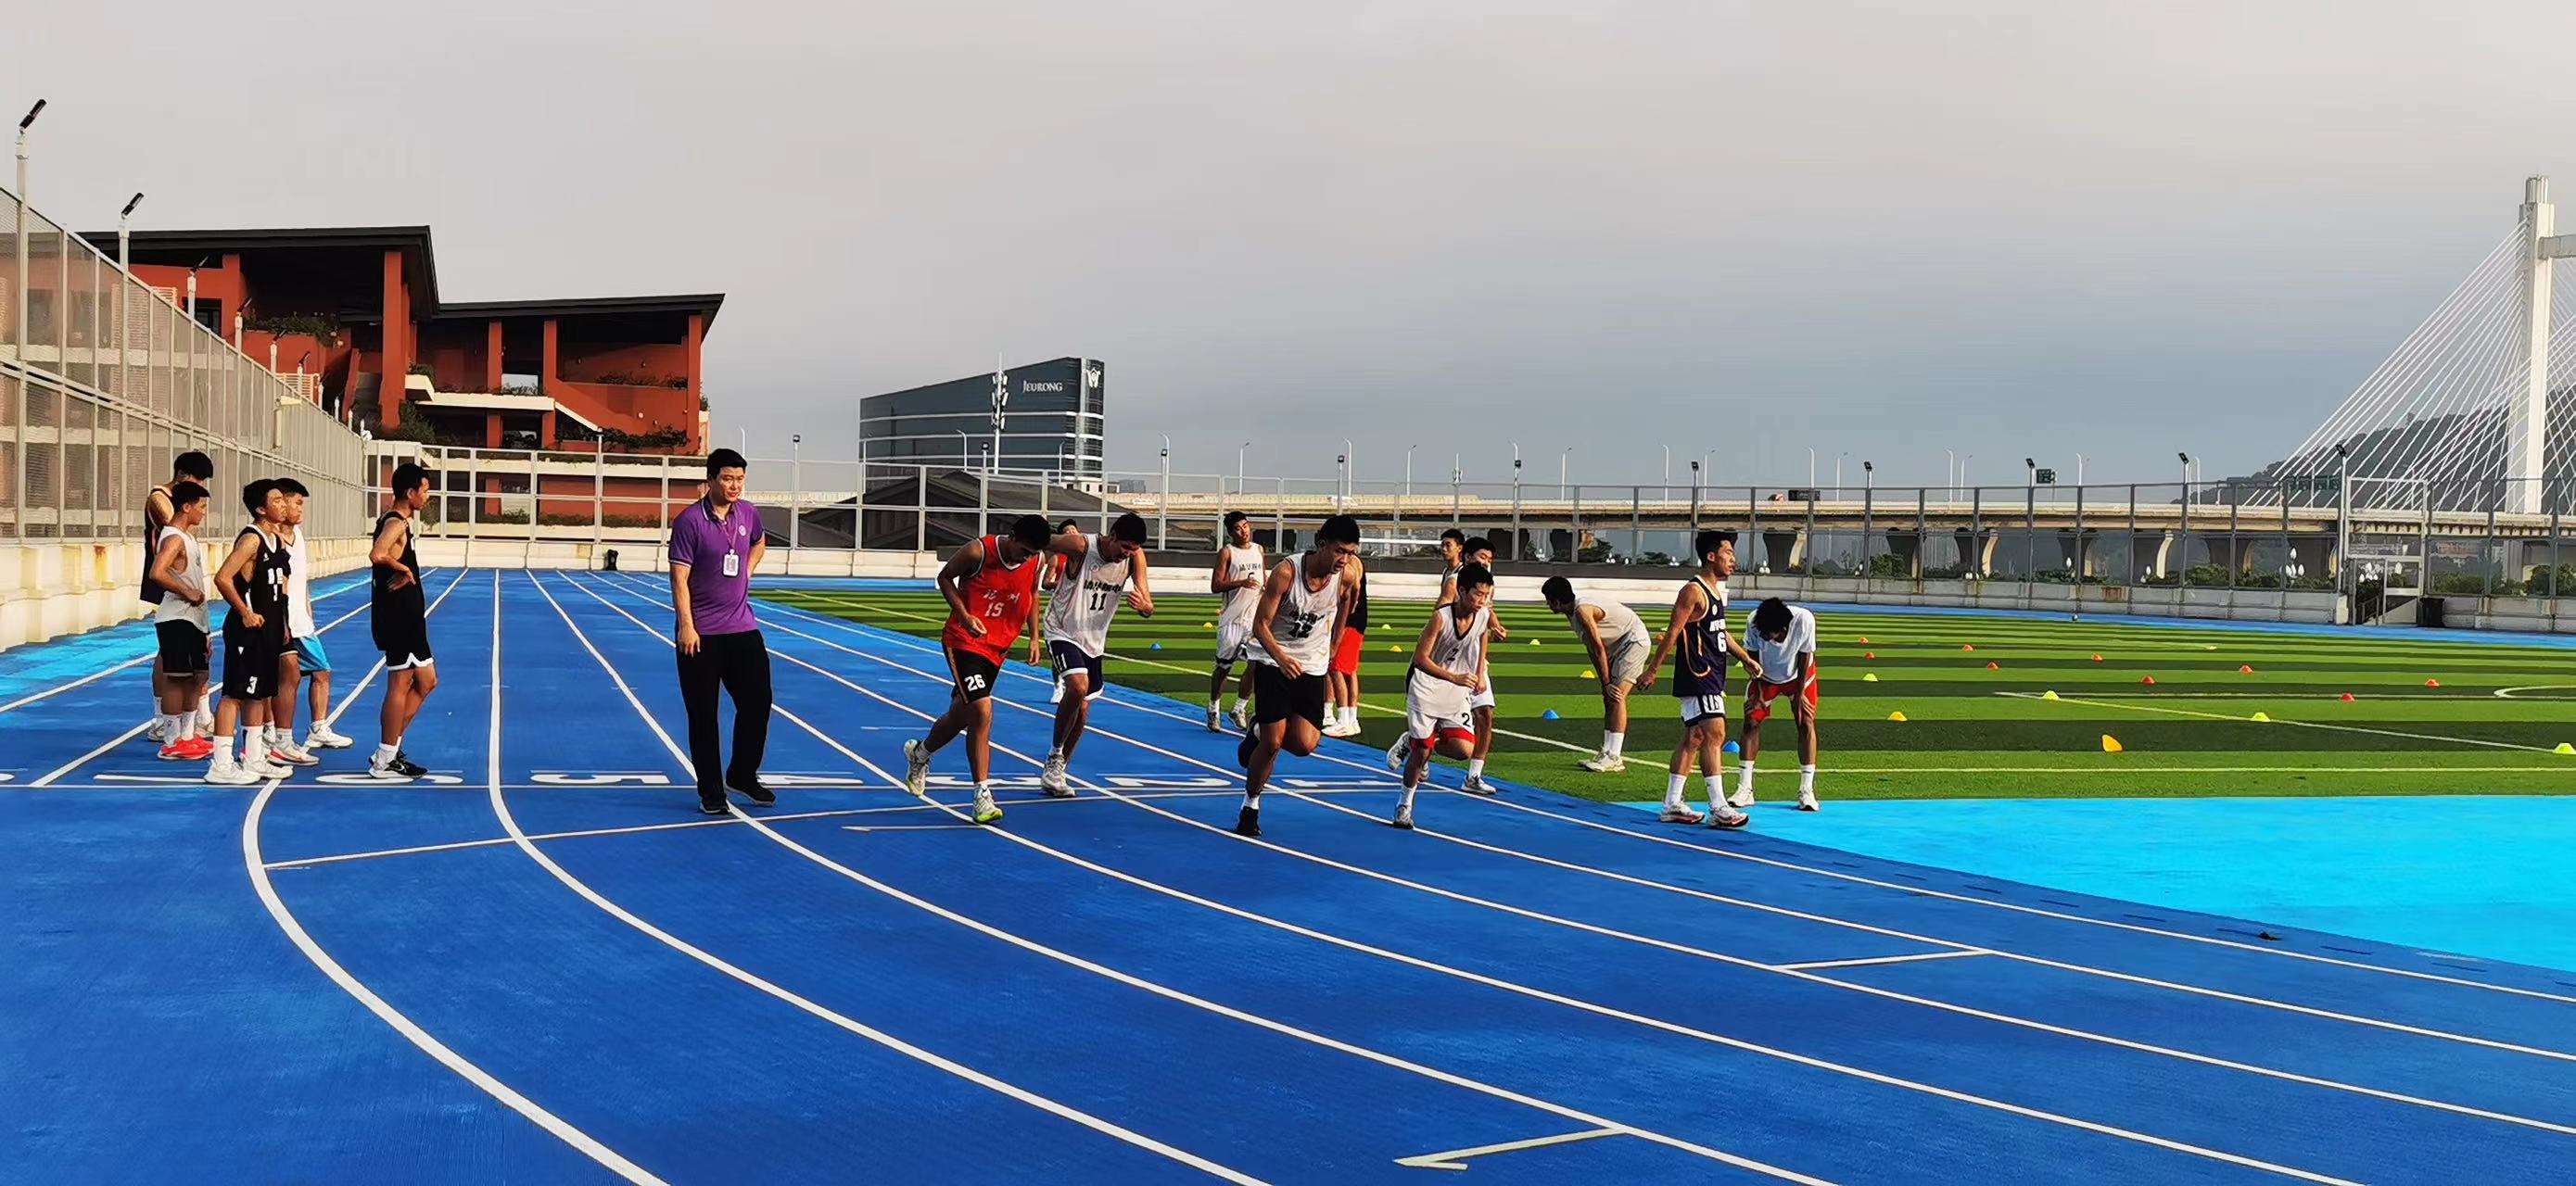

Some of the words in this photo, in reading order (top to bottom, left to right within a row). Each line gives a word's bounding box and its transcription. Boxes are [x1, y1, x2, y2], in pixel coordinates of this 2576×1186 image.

[1022, 380, 1063, 393] JEURONG
[984, 602, 1005, 616] 15
[1089, 593, 1107, 611] 11
[1717, 631, 1727, 652] 6
[1447, 648, 1459, 662] 2
[247, 675, 259, 694] 3
[964, 674, 986, 692] 26
[1462, 712, 1472, 727] 2
[530, 773, 670, 784] 5
[1104, 776, 1231, 787] 2
